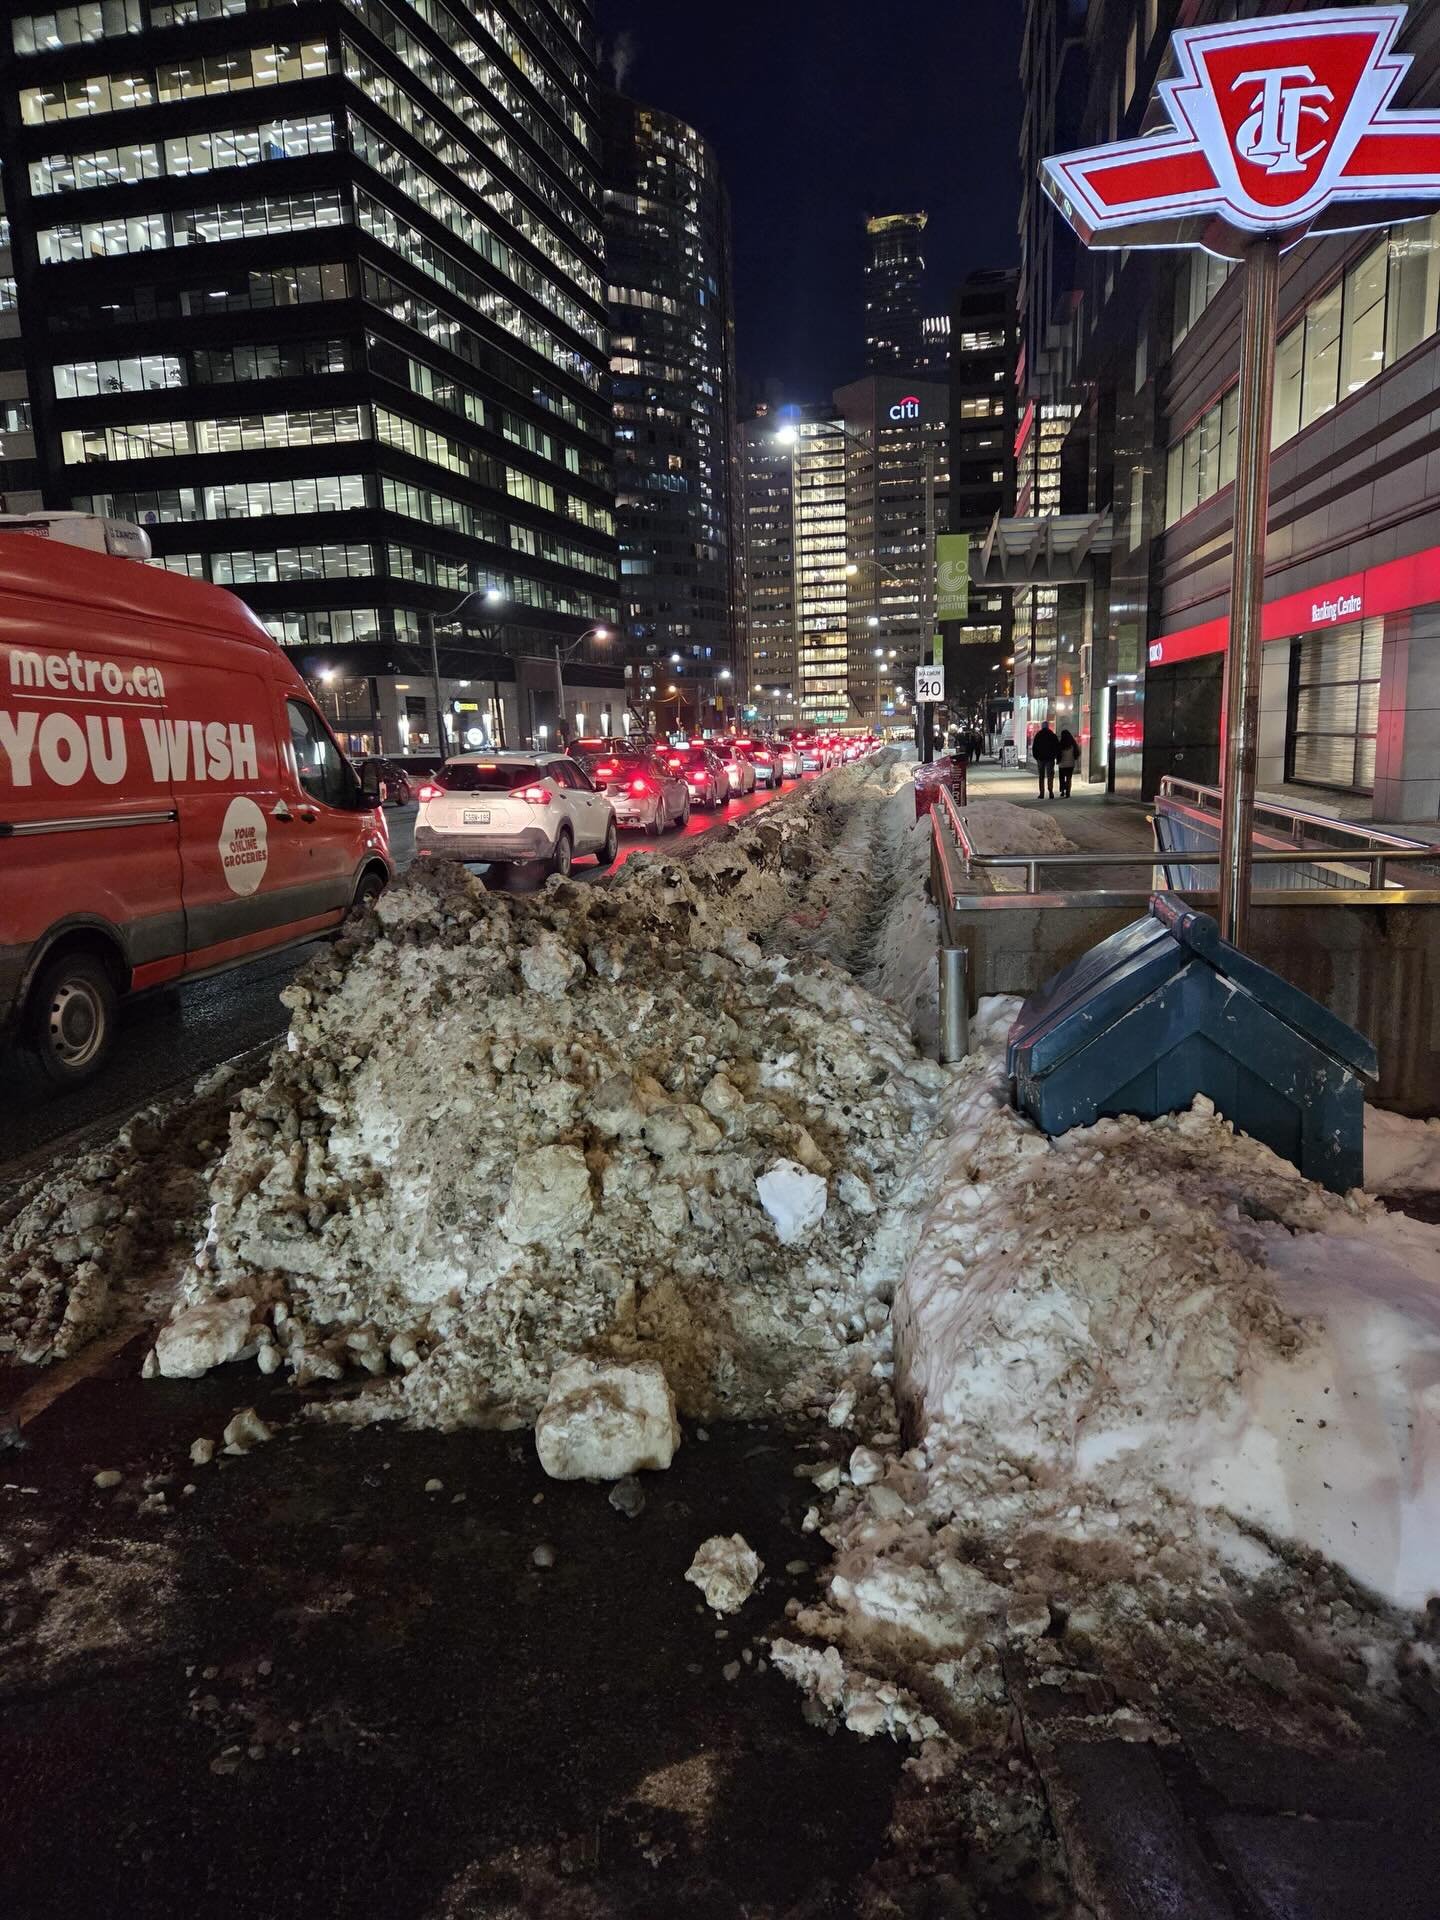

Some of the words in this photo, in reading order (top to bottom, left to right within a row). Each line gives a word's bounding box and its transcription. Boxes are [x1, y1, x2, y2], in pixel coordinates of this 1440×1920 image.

[1231, 65, 1335, 175] TTC
[890, 401, 919, 420] citi
[1312, 600, 1337, 622] Banking
[1338, 595, 1361, 616] Centre
[9, 650, 165, 698] metro.ca
[919, 681, 941, 696] 40
[0, 711, 127, 786] YOU
[139, 718, 259, 782] WISH
[234, 826, 256, 839] YOUR
[229, 838, 258, 854] ONLINE
[224, 850, 267, 867] GROCERIES
